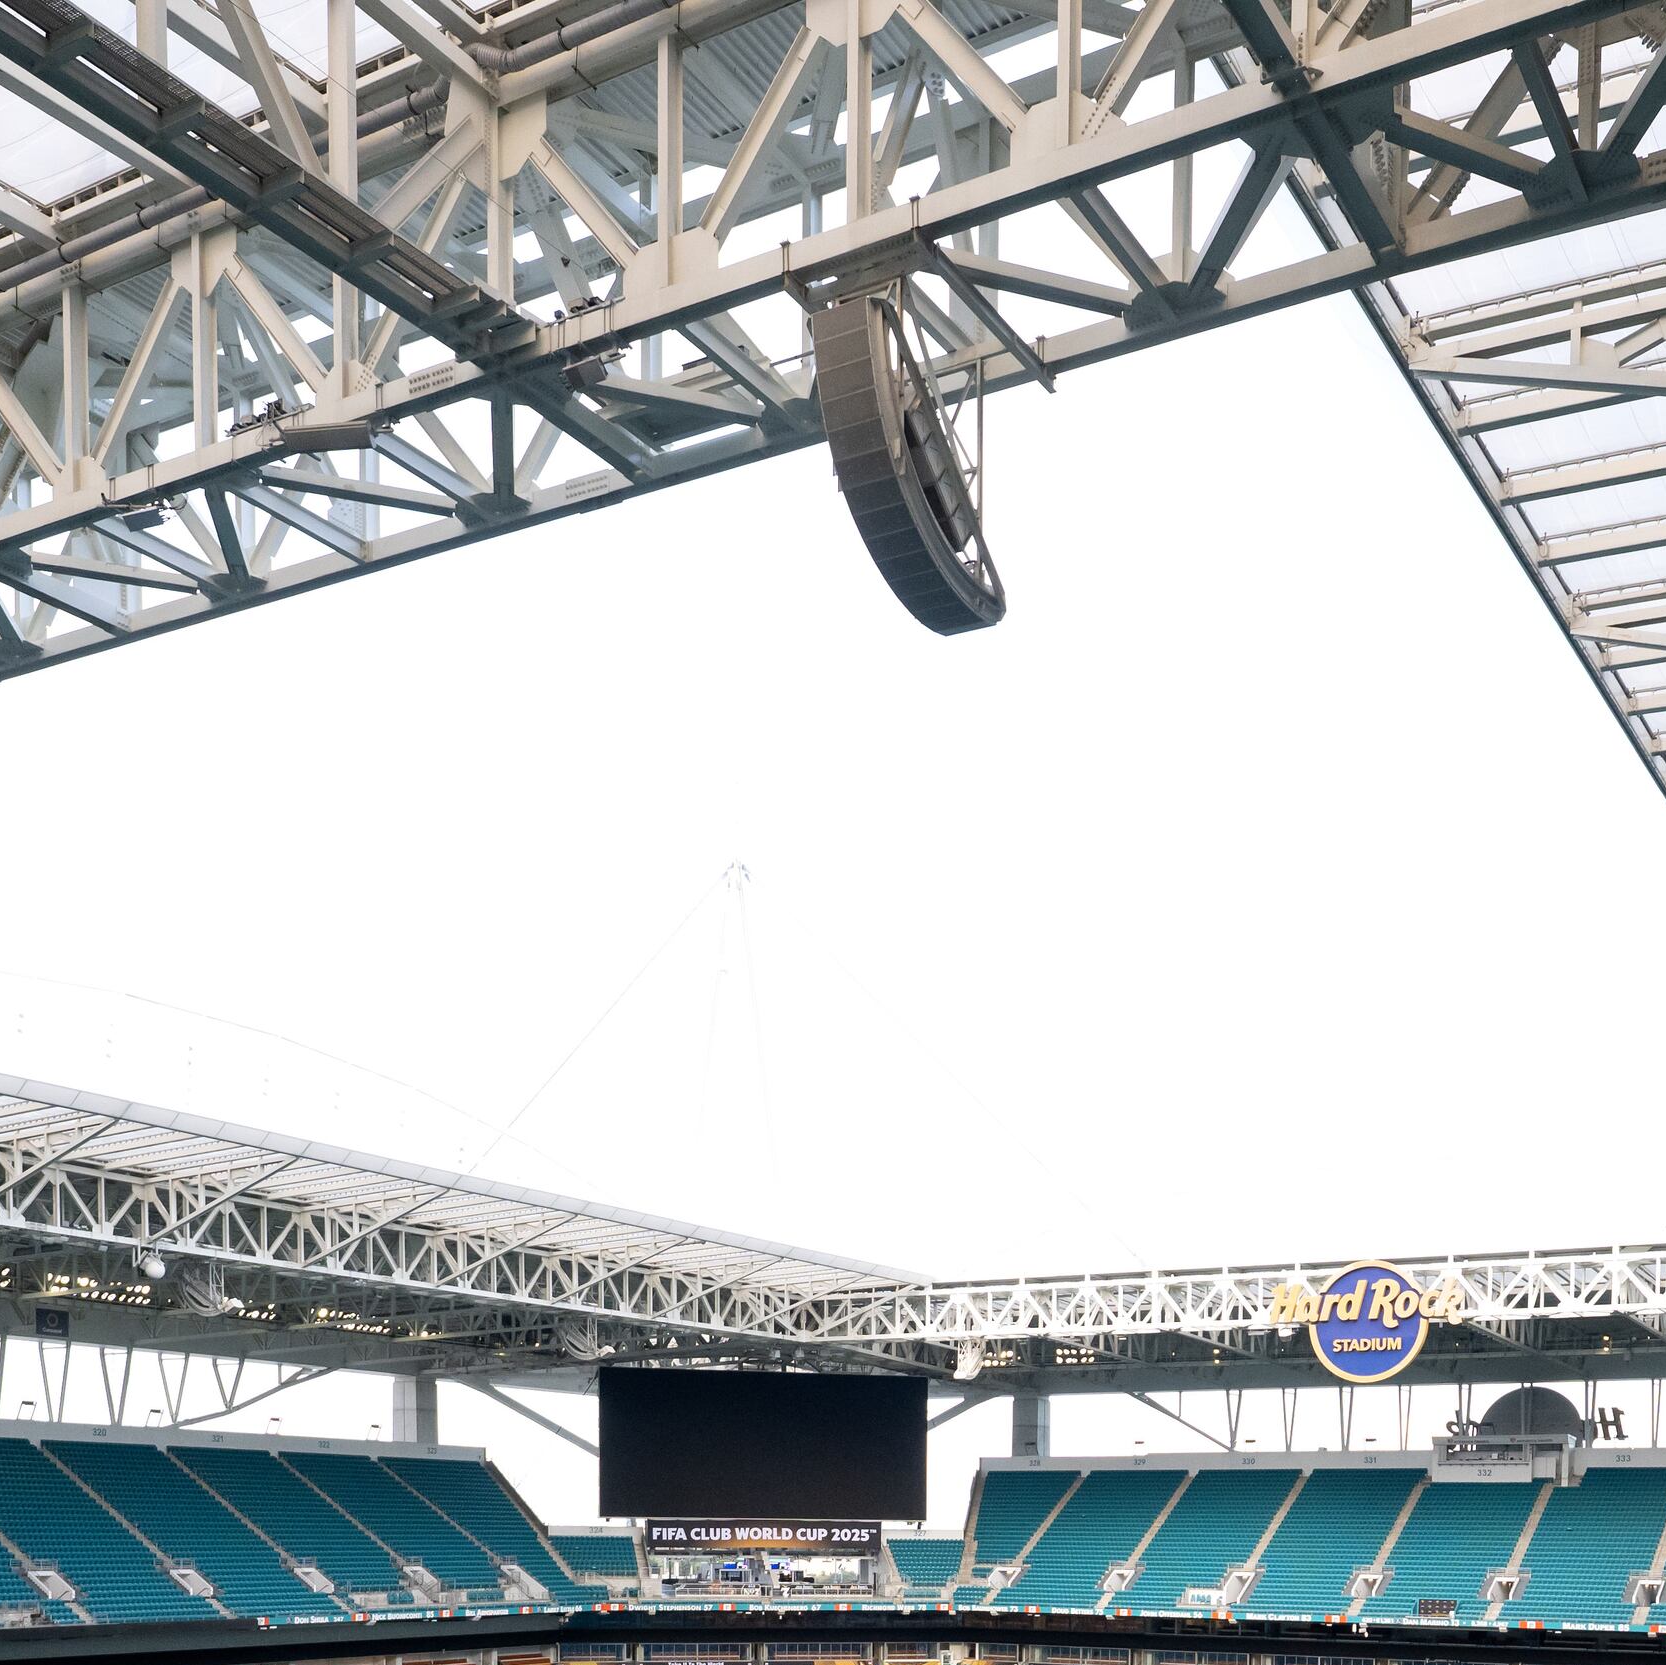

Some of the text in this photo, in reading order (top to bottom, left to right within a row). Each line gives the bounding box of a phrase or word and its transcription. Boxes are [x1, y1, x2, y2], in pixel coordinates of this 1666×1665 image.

[1270, 1277, 1464, 1328] Hard Rock
[1333, 1337, 1402, 1353] STADIUM
[92, 1428, 107, 1437] 320
[652, 1528, 688, 1541] FIFA
[690, 1528, 732, 1542] CLUB
[735, 1528, 793, 1542] WORLD
[796, 1528, 828, 1542] CUP
[658, 1604, 702, 1612] STEPHENSON
[294, 1616, 310, 1624] DON
